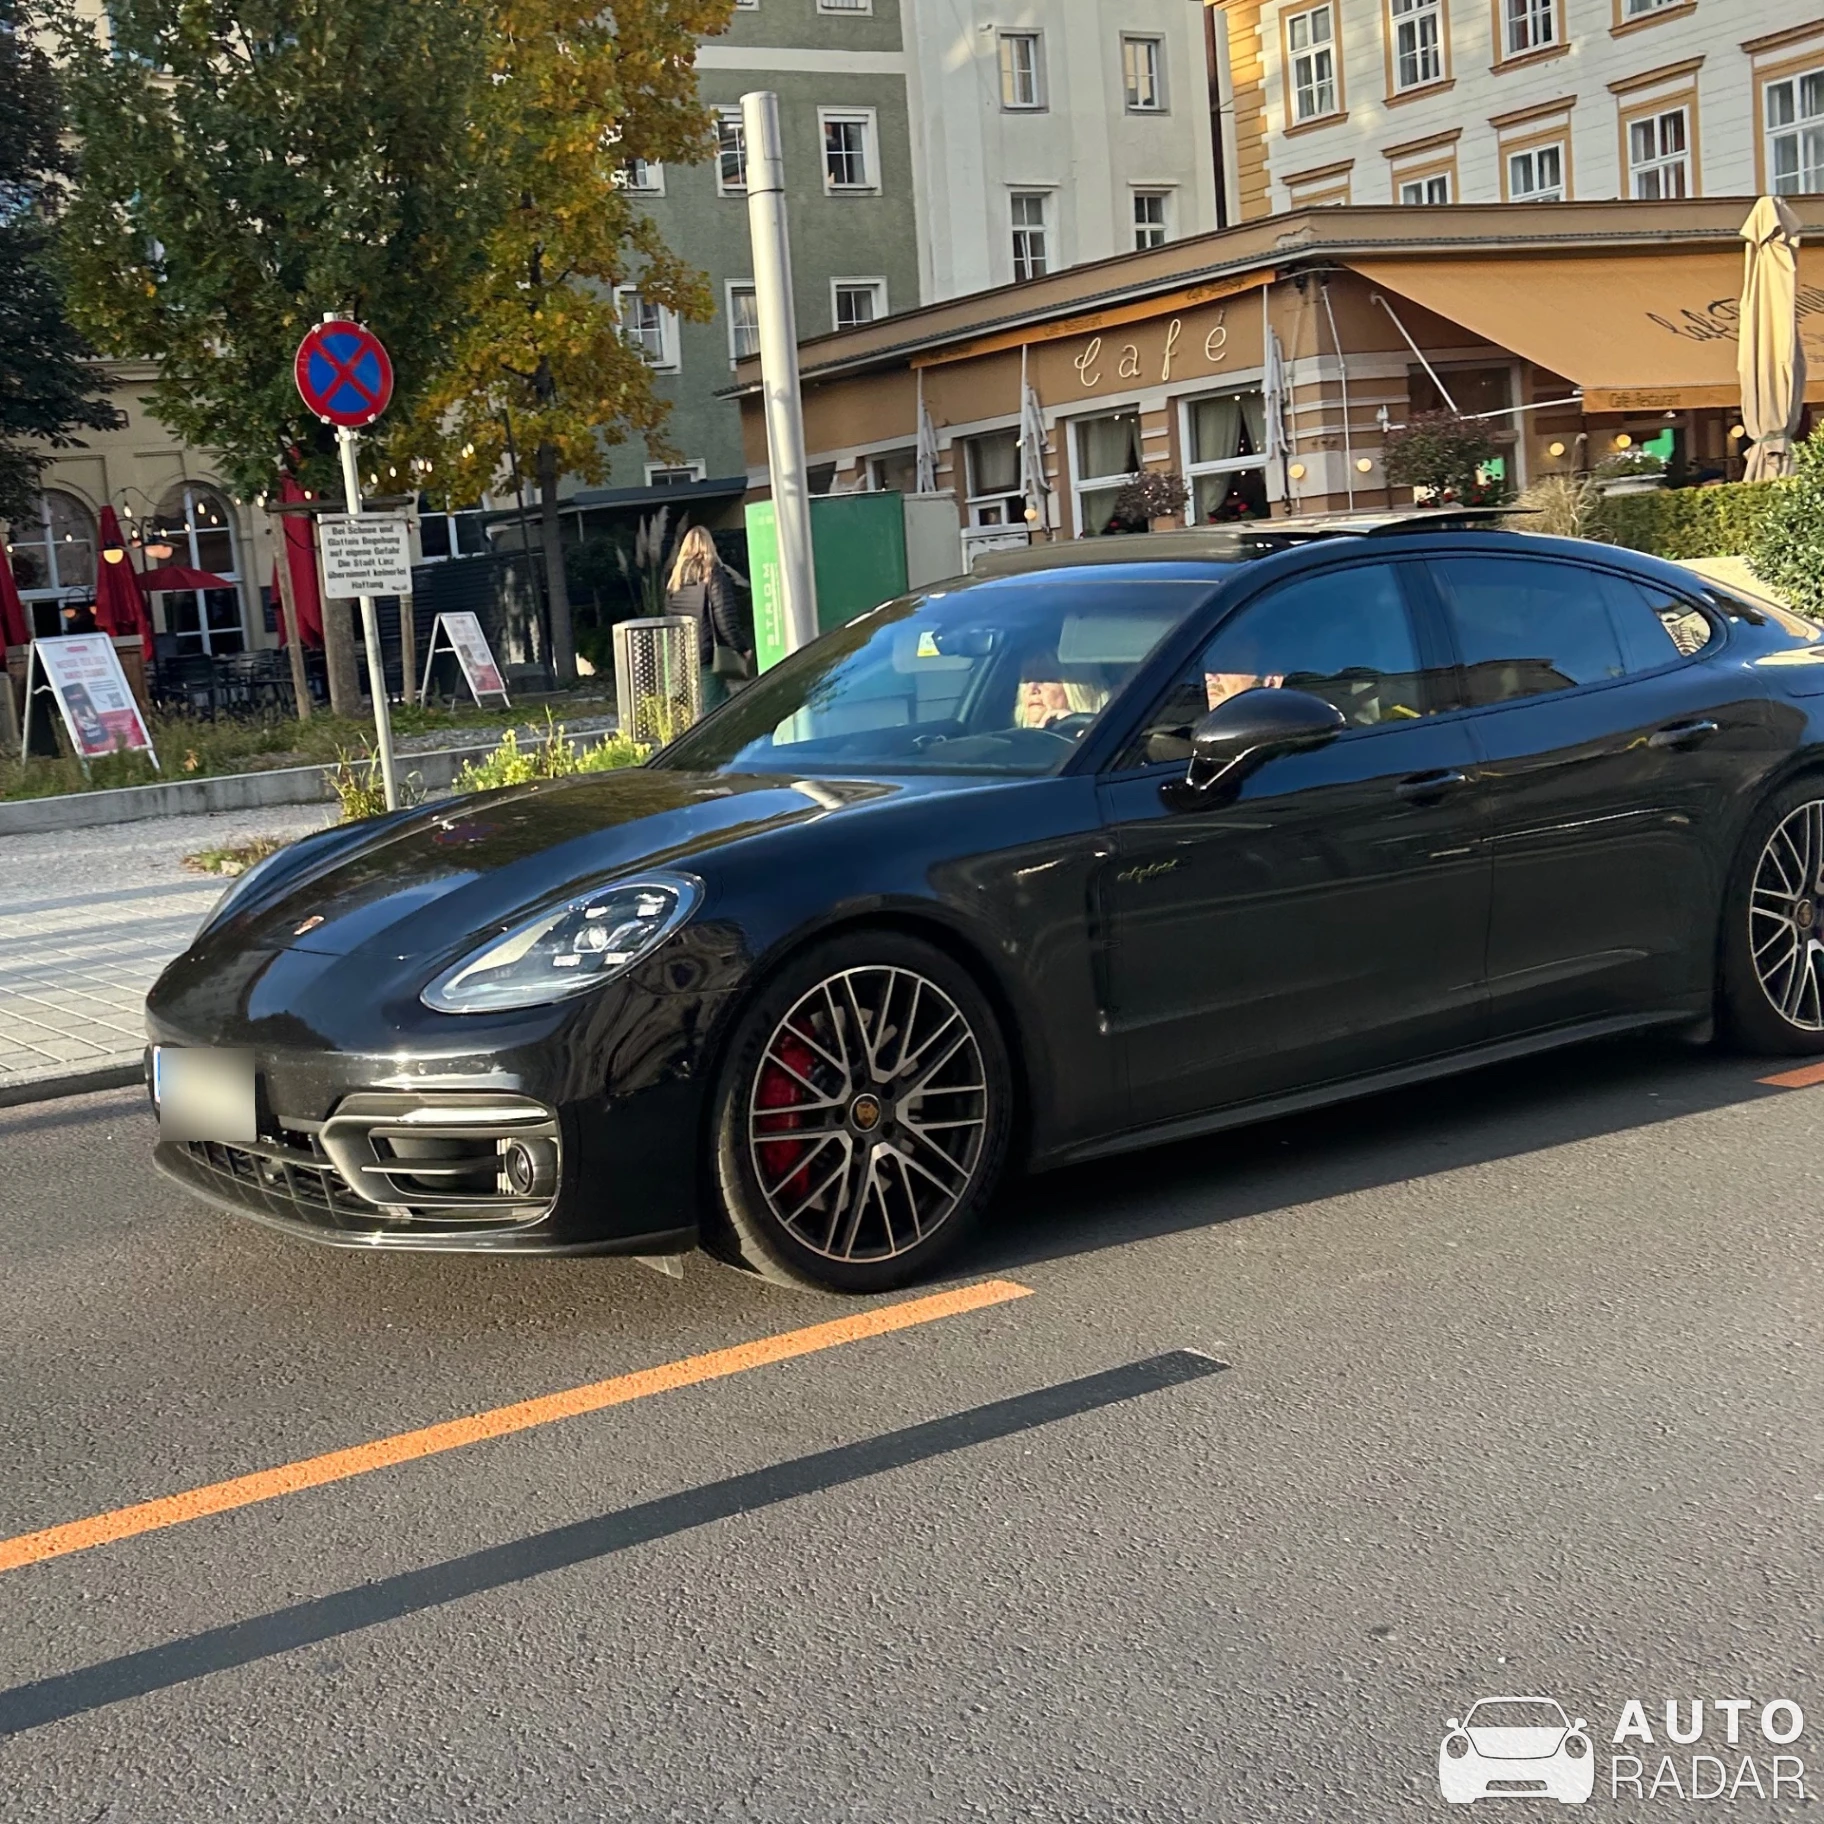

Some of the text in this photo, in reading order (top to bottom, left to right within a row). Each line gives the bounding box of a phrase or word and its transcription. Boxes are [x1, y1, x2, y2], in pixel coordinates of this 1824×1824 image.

[1074, 310, 1227, 387] Café
[332, 527, 345, 535] Bei
[380, 525, 393, 533] und
[330, 549, 342, 557] auf
[374, 547, 400, 555] Gefahr
[338, 559, 351, 567] Die
[353, 558, 375, 567] Stadt
